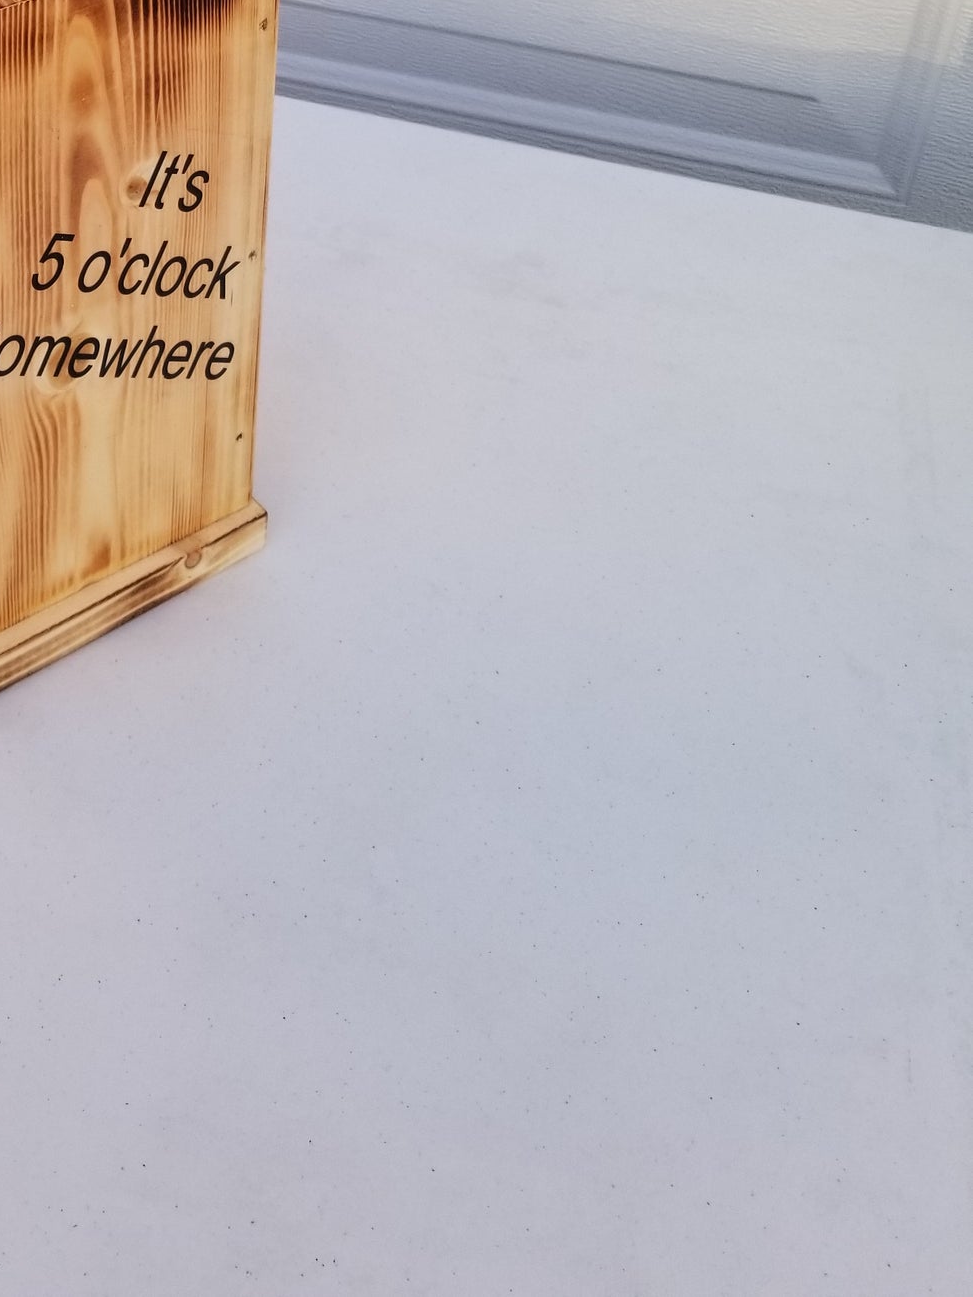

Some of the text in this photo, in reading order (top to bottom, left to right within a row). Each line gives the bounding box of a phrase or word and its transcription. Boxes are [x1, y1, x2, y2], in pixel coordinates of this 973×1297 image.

[138, 150, 210, 213] It's
[31, 232, 240, 300] 5 o'clock
